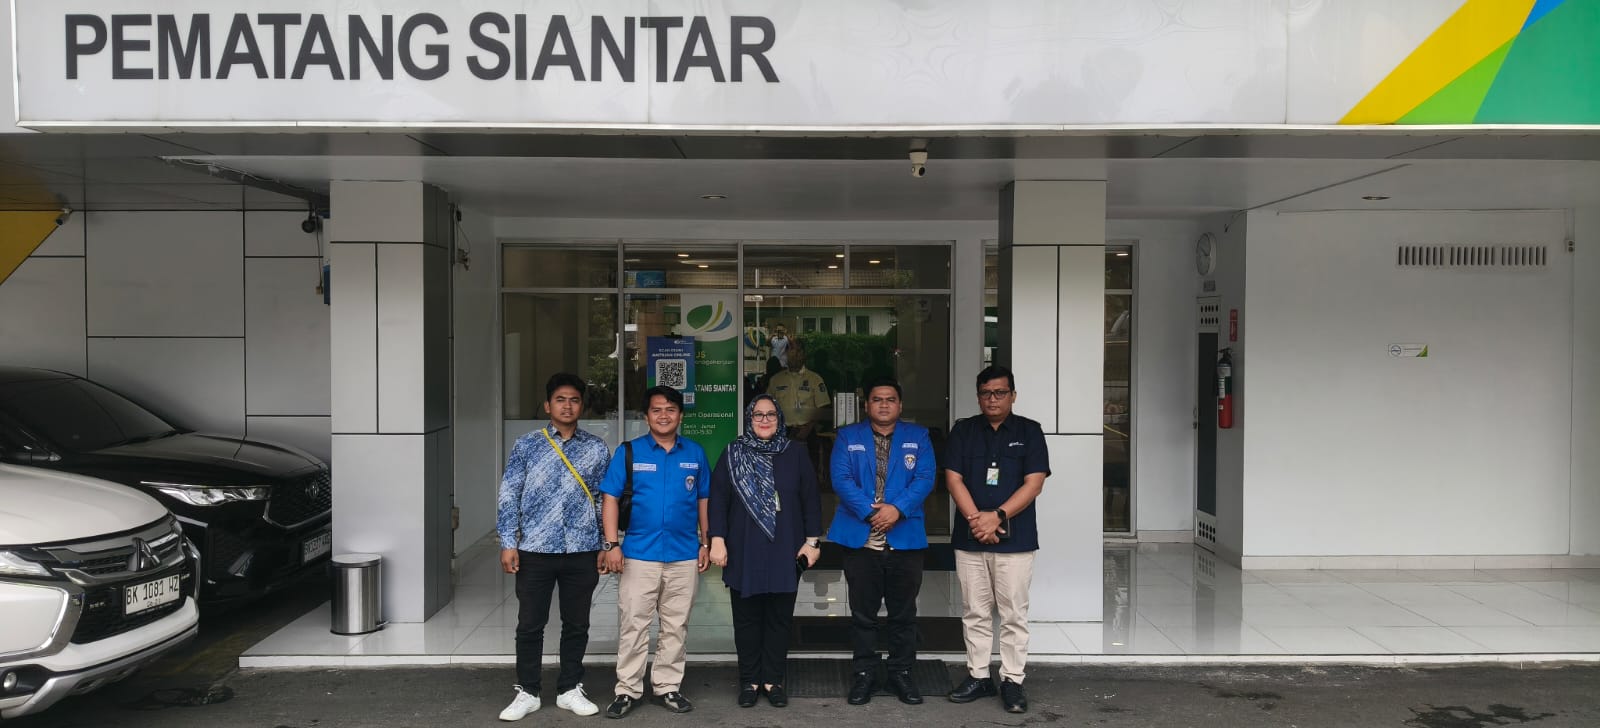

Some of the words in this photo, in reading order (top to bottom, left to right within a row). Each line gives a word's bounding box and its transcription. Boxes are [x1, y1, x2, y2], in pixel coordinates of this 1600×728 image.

[65, 13, 449, 80] PEMATANG
[466, 12, 779, 82] SIANTAR
[713, 384, 737, 392] SIANTAR
[698, 411, 734, 419] Operasional
[126, 586, 138, 605] BK
[143, 580, 164, 600] 1081
